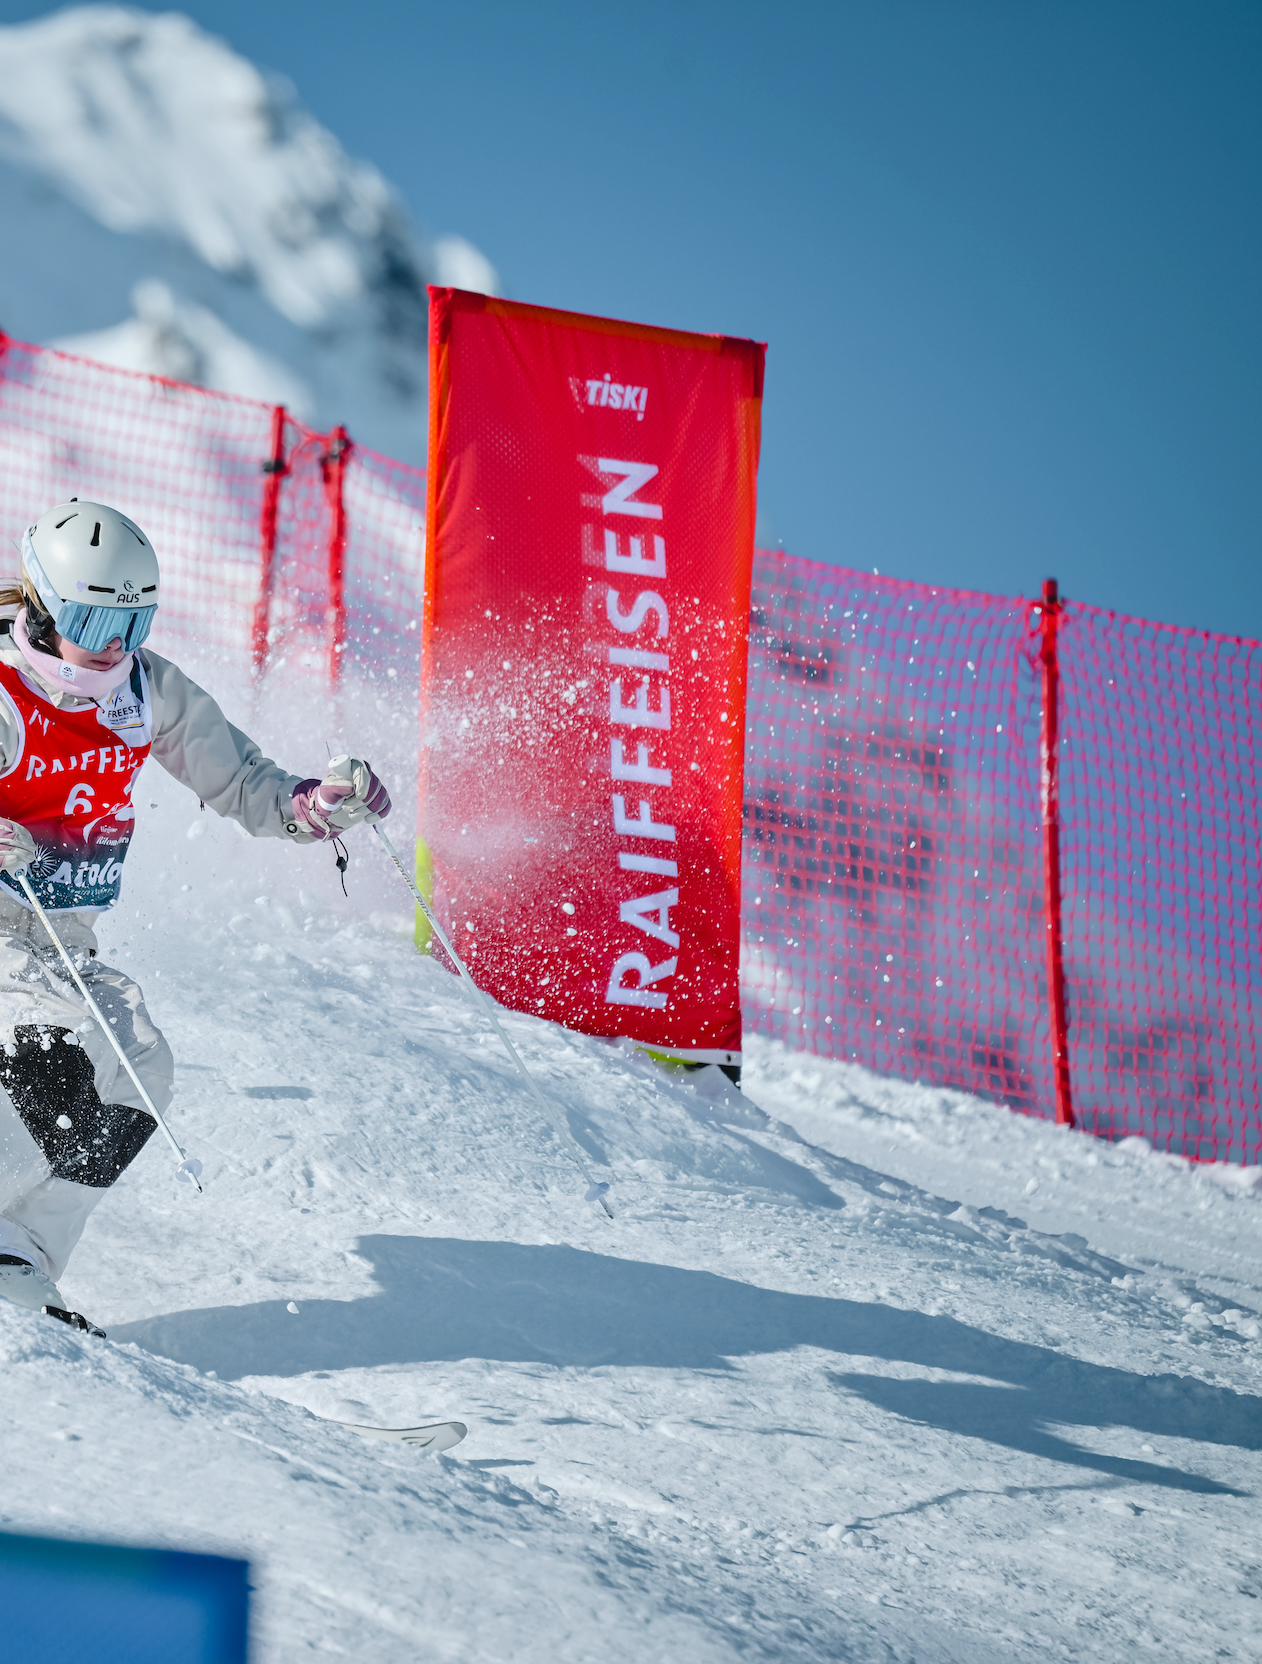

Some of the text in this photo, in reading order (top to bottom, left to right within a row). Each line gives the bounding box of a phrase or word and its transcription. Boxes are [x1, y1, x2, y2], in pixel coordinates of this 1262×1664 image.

[117, 593, 140, 604] AUS
[108, 706, 141, 718] FREEST
[598, 457, 680, 1010] RAIFFEISEN
[26, 745, 146, 781] RAIFFE
